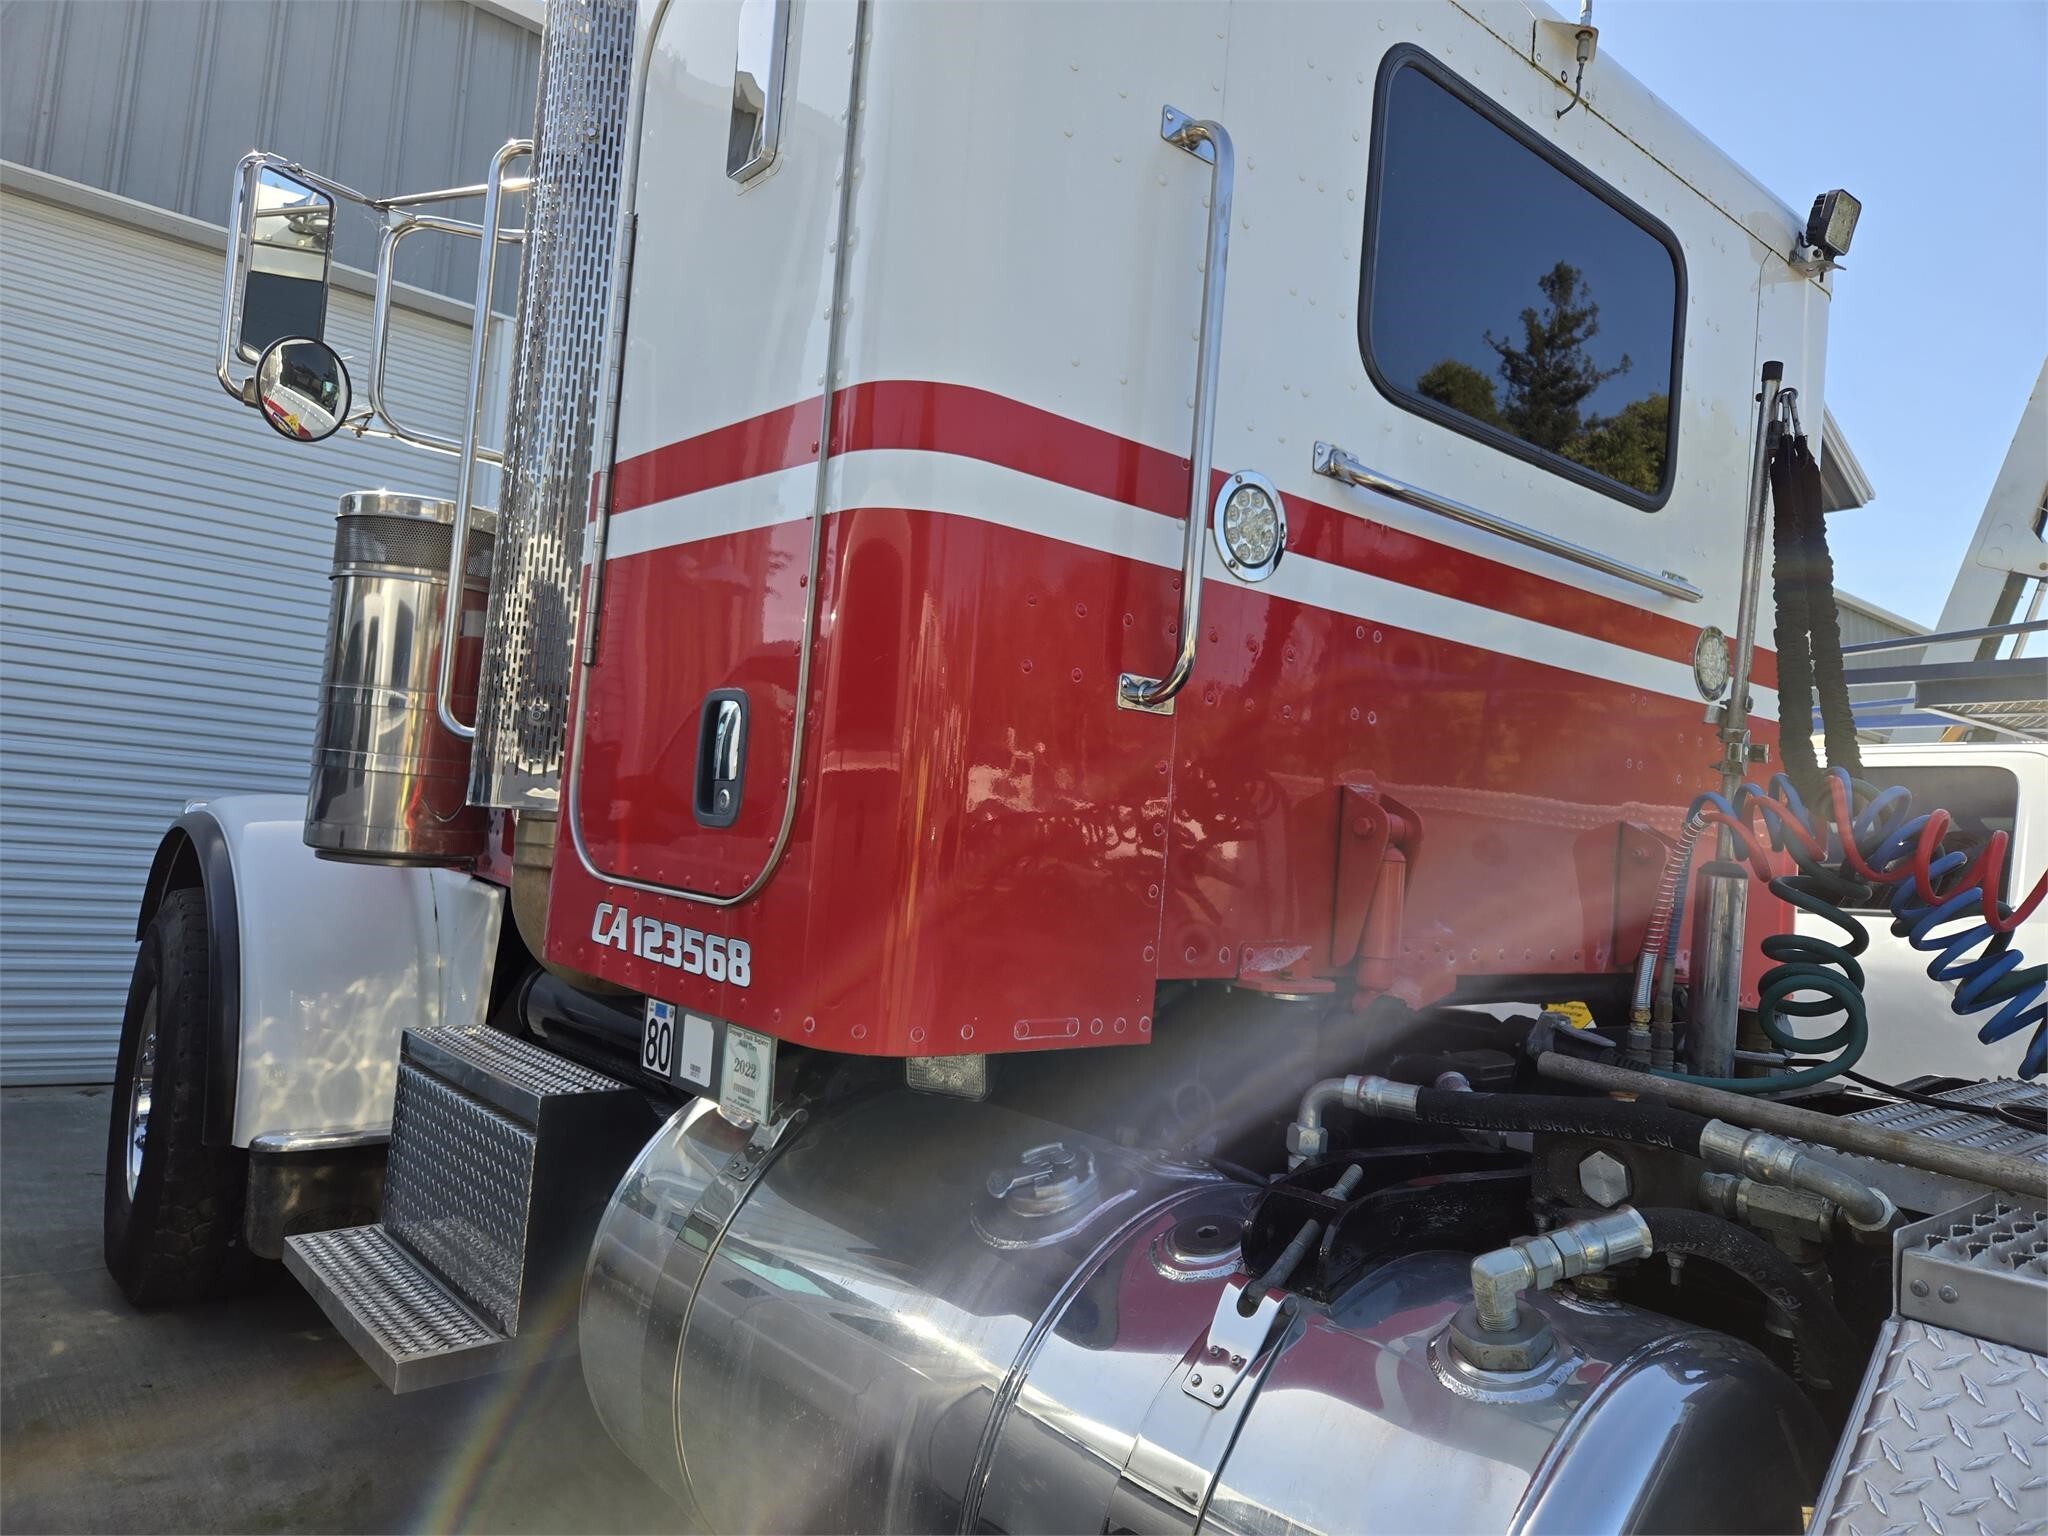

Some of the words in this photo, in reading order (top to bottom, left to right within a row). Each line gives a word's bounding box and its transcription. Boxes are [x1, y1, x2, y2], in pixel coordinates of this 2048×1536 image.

[591, 901, 628, 951] CA
[632, 914, 751, 988] 123568
[645, 1017, 671, 1072] 80
[734, 1057, 757, 1080] 2022
